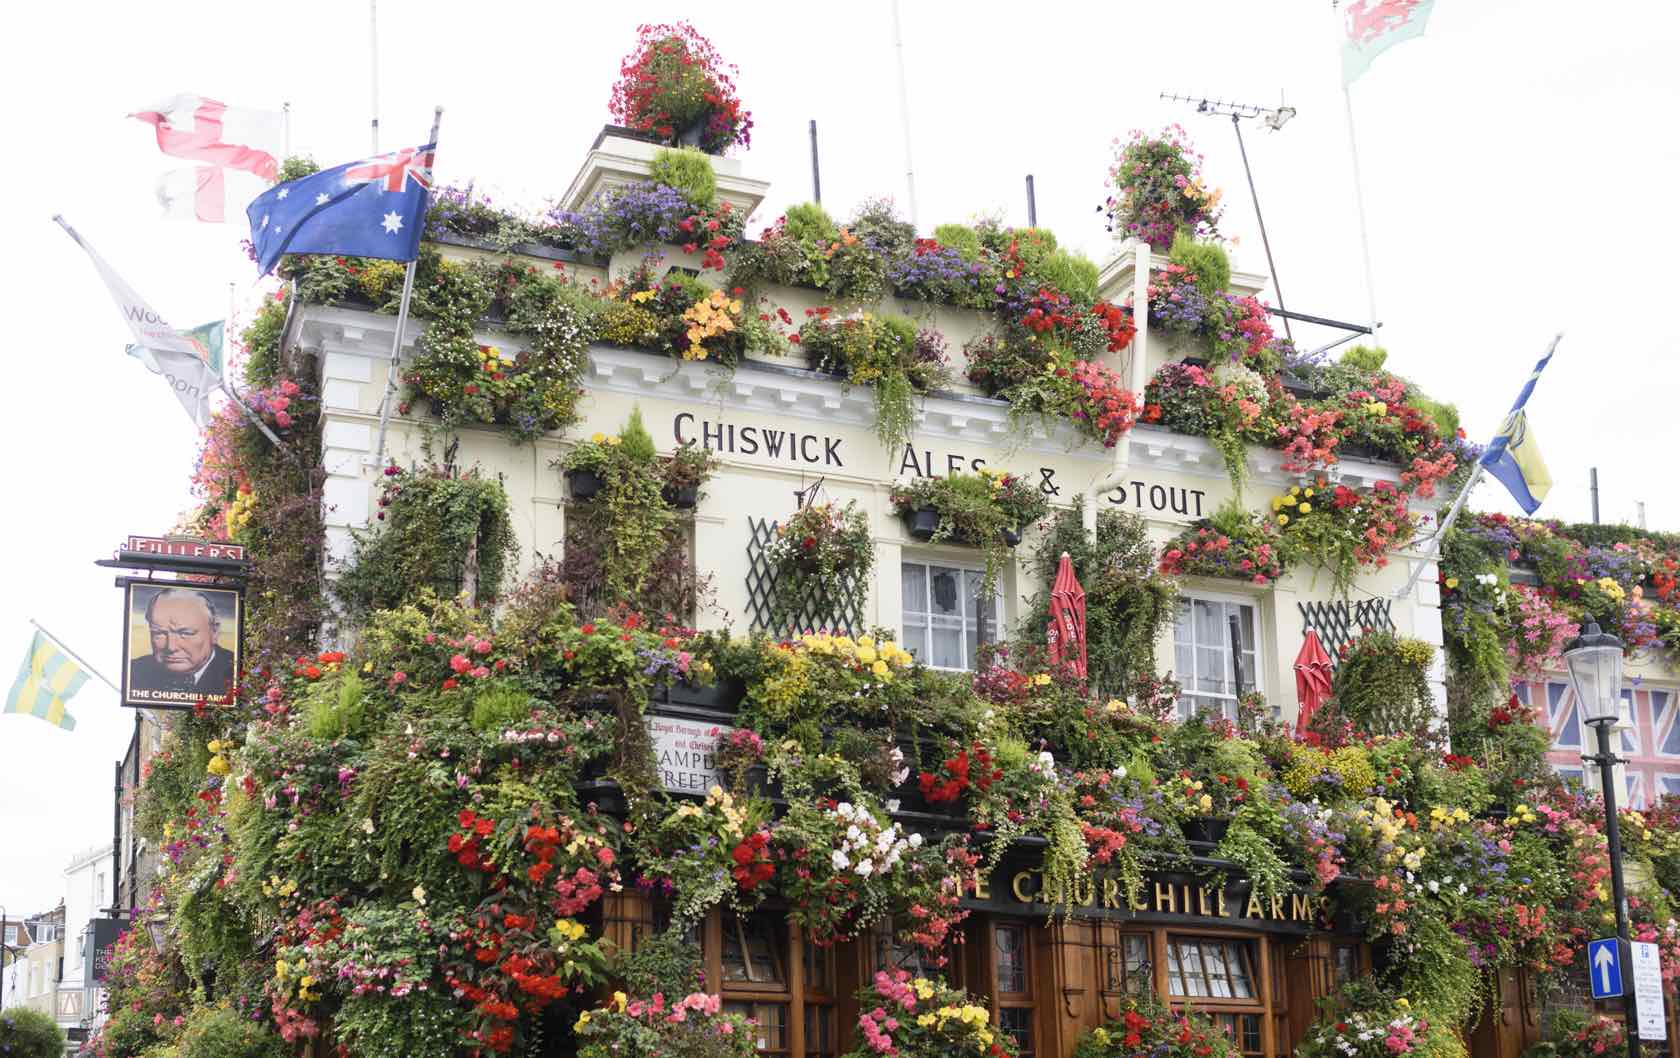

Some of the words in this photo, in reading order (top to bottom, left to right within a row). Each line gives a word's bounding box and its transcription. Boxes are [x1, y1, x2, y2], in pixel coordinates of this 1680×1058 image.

[673, 412, 844, 467] CHISWICK
[1039, 467, 1061, 497] &
[131, 688, 150, 699] THE
[151, 690, 204, 702] CHURCHILL
[206, 694, 228, 703] ARM
[660, 749, 716, 770] AMPD
[664, 770, 711, 790] REET
[1012, 871, 1231, 918] CHURCHILL
